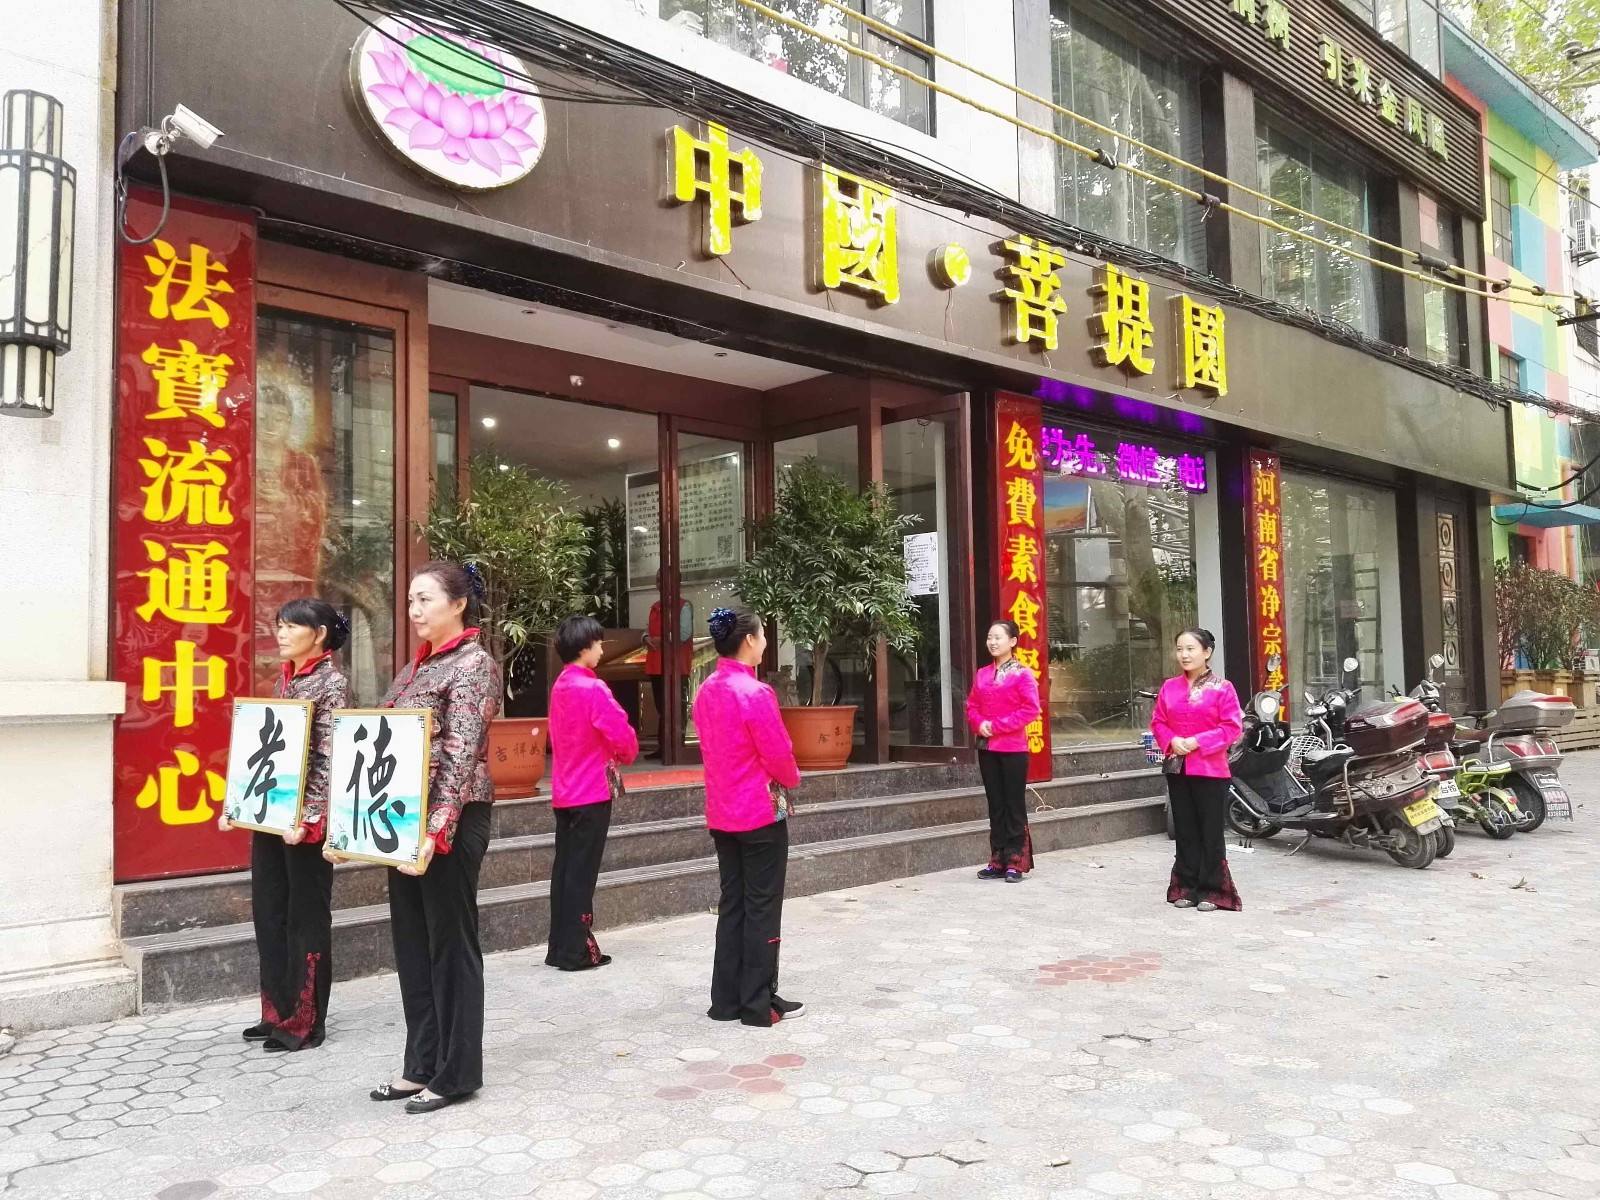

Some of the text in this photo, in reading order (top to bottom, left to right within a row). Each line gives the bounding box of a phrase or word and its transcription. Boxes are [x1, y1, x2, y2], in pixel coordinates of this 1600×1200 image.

[136, 238, 234, 827] 法寶流通中心
[1256, 471, 1285, 722] 河南省净宗学
[244, 706, 286, 824] 孝
[346, 715, 406, 854] 德
[496, 741, 544, 762] 吉祥如
